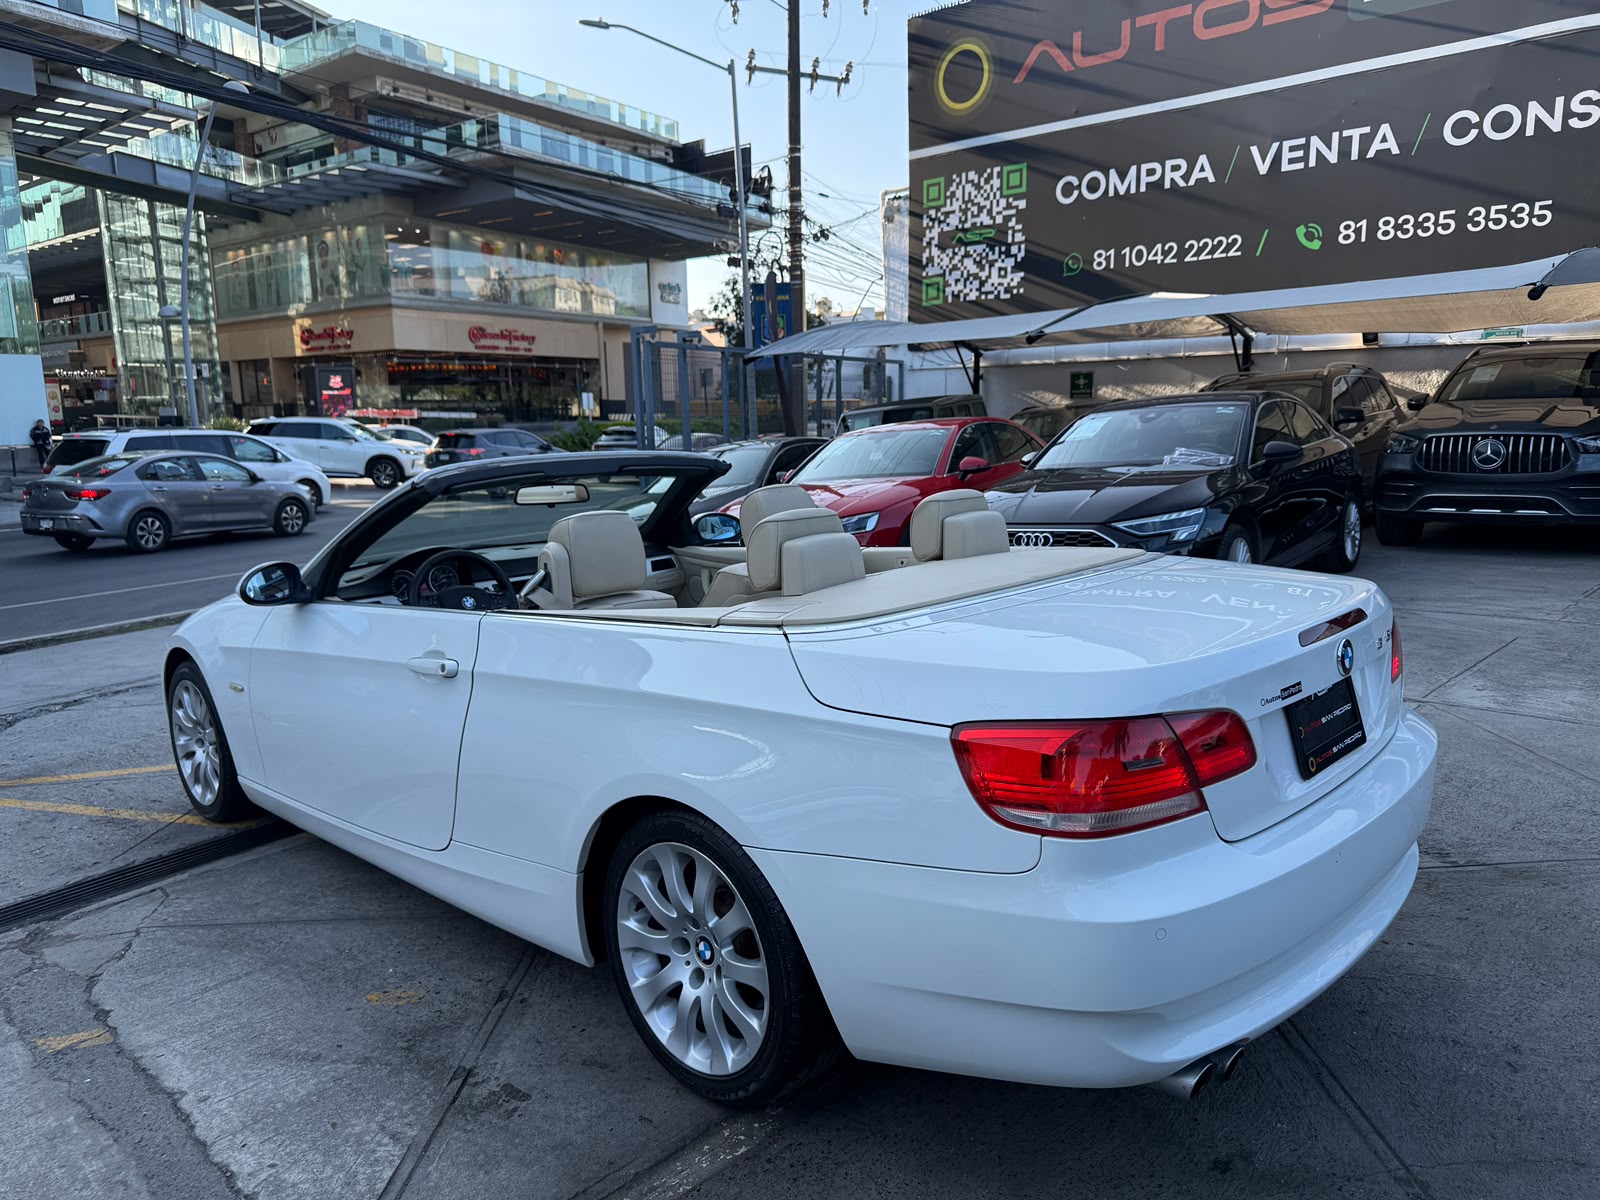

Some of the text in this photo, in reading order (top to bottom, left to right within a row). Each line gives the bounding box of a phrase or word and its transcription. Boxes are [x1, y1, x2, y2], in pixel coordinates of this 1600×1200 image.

[1055, 154, 1216, 205] COMPRA
[1249, 123, 1401, 176] VENTA
[1442, 89, 1600, 146] CONS
[1092, 248, 1115, 271] 81
[1121, 242, 1178, 269] 1042
[1183, 233, 1242, 263] 2222
[1337, 218, 1368, 245] 81
[1376, 210, 1456, 241] 8335
[1466, 200, 1554, 232] 3535
